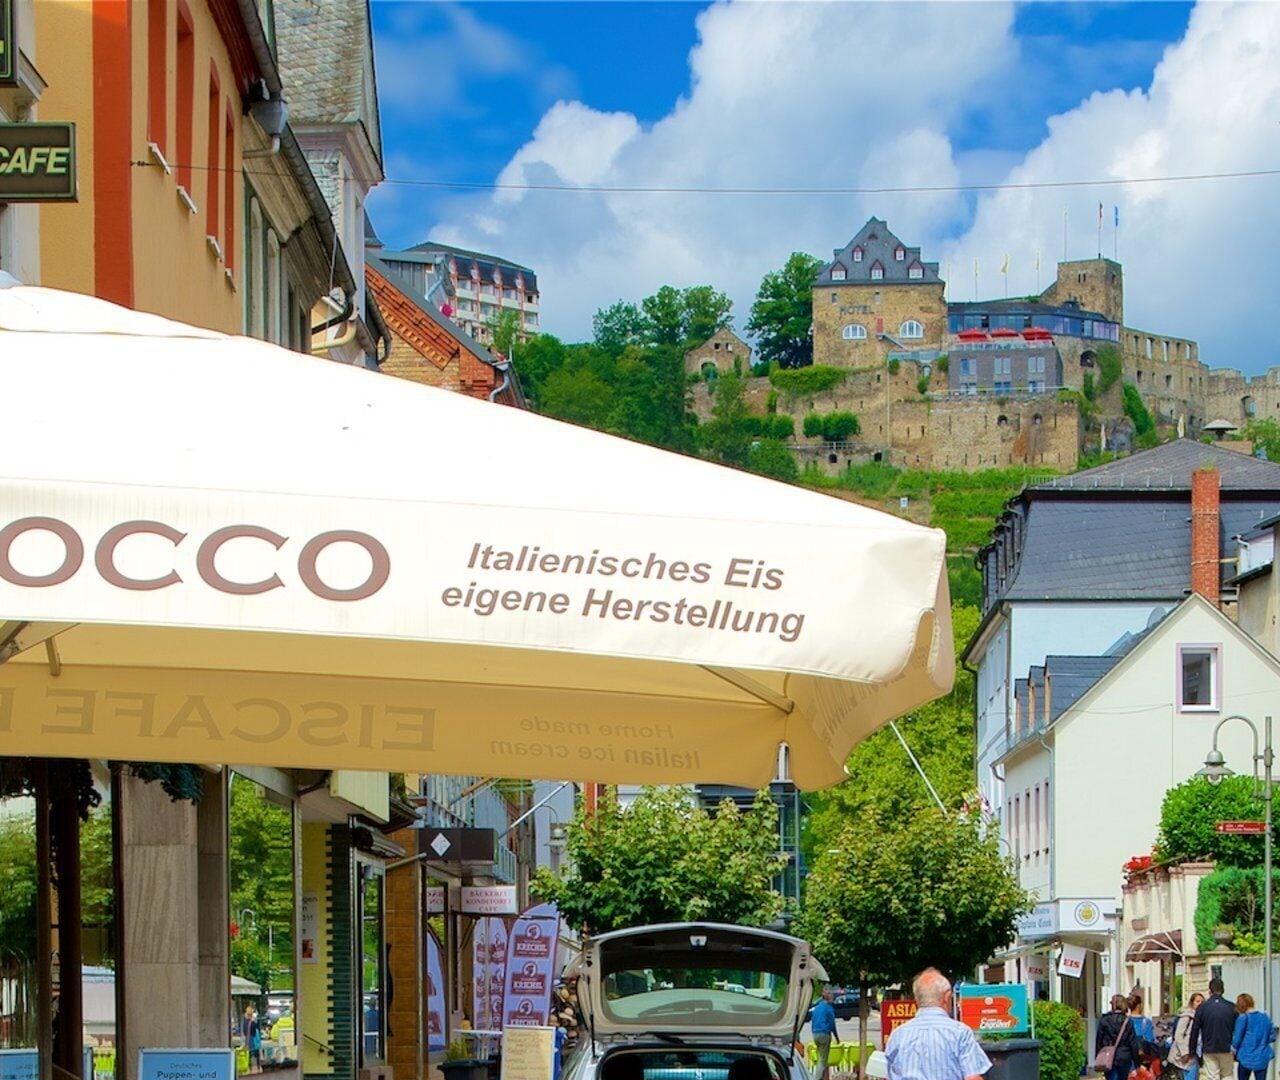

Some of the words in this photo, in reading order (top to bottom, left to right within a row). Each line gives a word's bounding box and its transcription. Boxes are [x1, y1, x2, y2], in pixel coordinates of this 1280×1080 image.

[840, 304, 875, 315] HOTEL
[466, 542, 712, 585] Italienisches
[724, 557, 786, 590] Eis
[440, 581, 571, 616] eigene
[581, 588, 807, 642] Herstellung
[1063, 958, 1081, 968] EIS
[887, 1004, 917, 1017] ASIA
[156, 1071, 196, 1080] Puppen-
[199, 1071, 217, 1079] und
